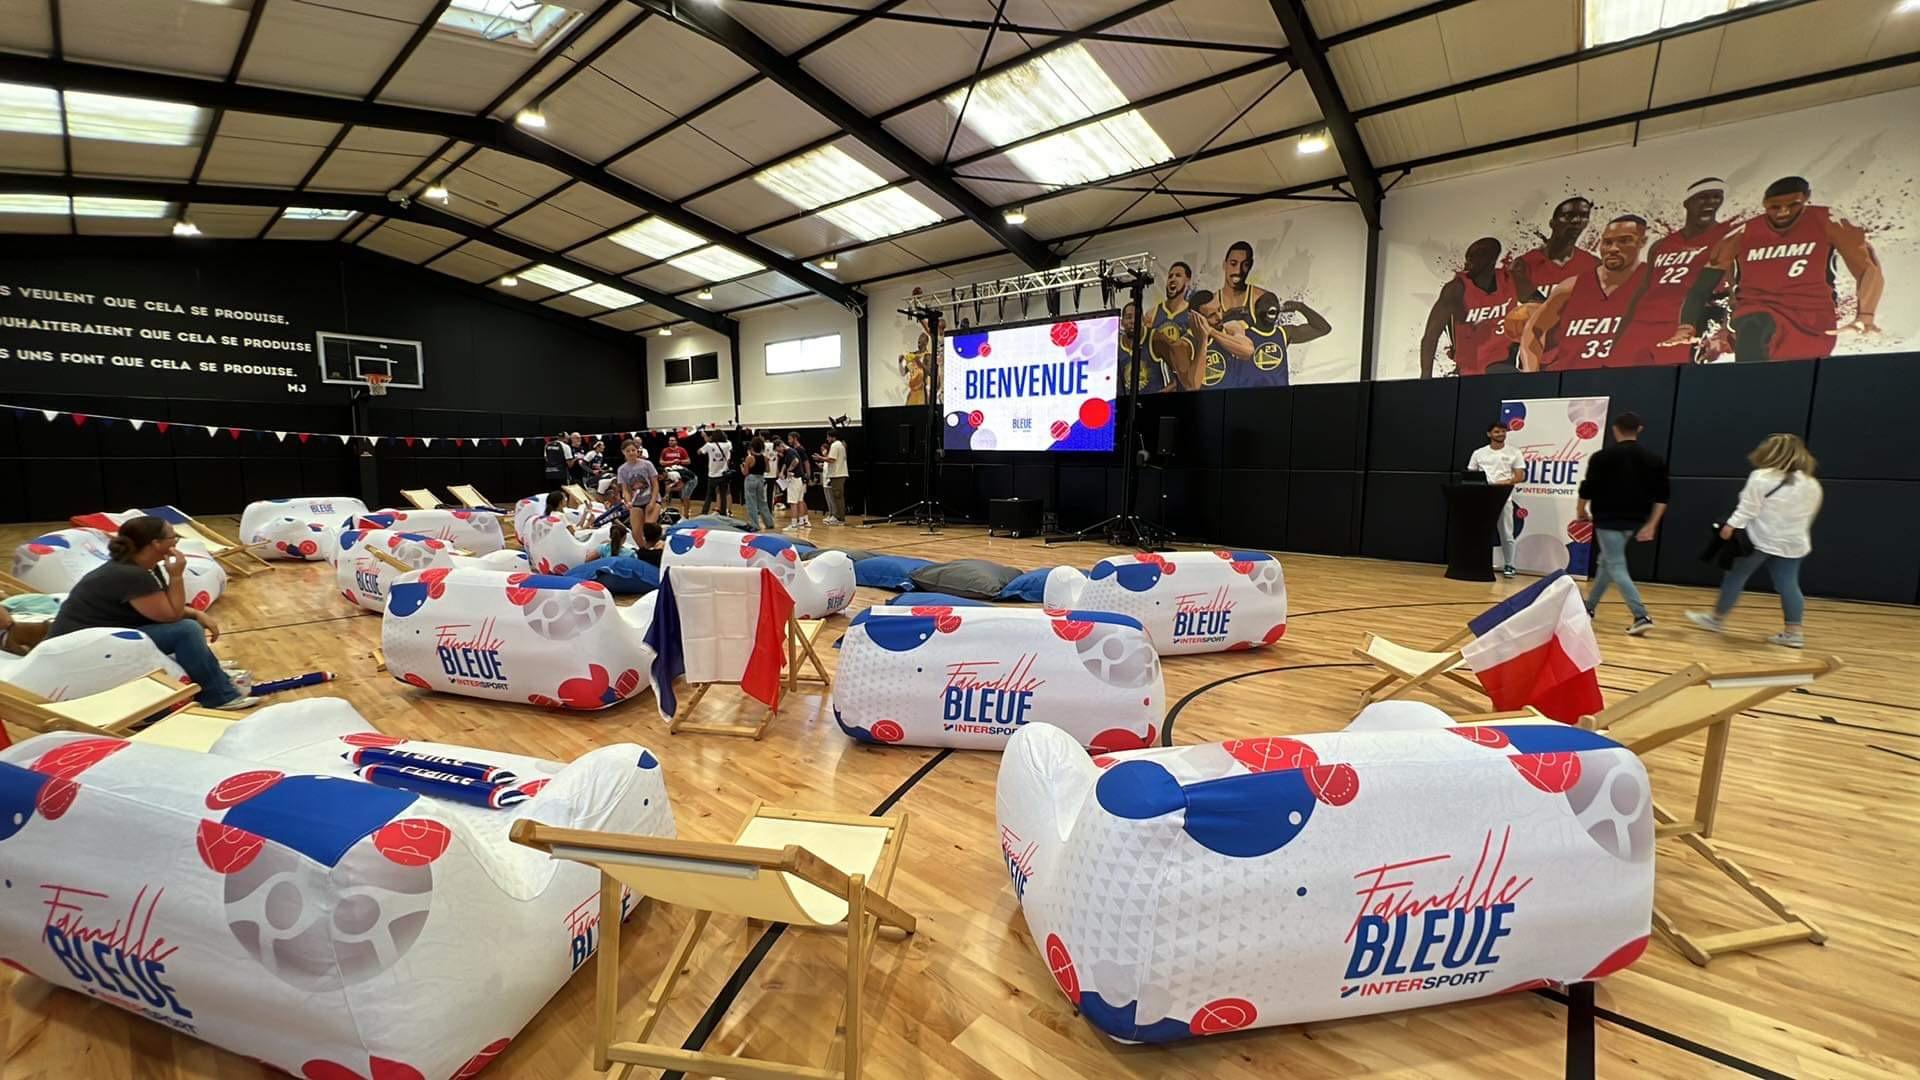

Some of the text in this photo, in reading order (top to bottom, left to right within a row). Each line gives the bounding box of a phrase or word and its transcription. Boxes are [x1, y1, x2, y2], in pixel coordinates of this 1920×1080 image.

[1654, 246, 1708, 267] HEAT
[1747, 242, 1816, 261] MIAMI
[1659, 267, 1689, 284] 22
[1788, 260, 1808, 277] 6
[18, 287, 95, 304] VEULENT
[103, 297, 137, 308] QUE
[144, 301, 185, 314] CELA
[190, 306, 208, 316] SE
[215, 308, 290, 325] PRODUISE.
[1465, 298, 1512, 323] HEAT
[139, 329, 171, 341] QUE
[177, 332, 216, 344] CELA
[221, 336, 239, 346] SE
[243, 338, 312, 352] PRODUISE
[1265, 344, 1278, 353] 23
[1581, 340, 1613, 359] 33
[17, 349, 54, 362] UNS
[60, 352, 105, 365] FONT
[111, 356, 145, 368] QUE
[150, 359, 192, 371] CELA
[199, 362, 218, 372] SE
[224, 364, 298, 377] PRODUISE.
[965, 360, 1089, 400] BIENVENUE
[1523, 487, 1574, 495] INTERSPORT
[1172, 584, 1239, 621] Famille
[435, 616, 505, 655] Famille
[1174, 610, 1231, 636] BLEUE
[438, 645, 507, 681] BLEUE
[940, 653, 1046, 698] Famille
[943, 686, 1034, 725] BLEUE
[1344, 825, 1534, 943] Famille
[40, 884, 179, 962] Famille
[1344, 902, 1515, 980] BLEUE
[47, 925, 193, 1019] BLEUE
[1360, 970, 1489, 997] INTERSPORT
